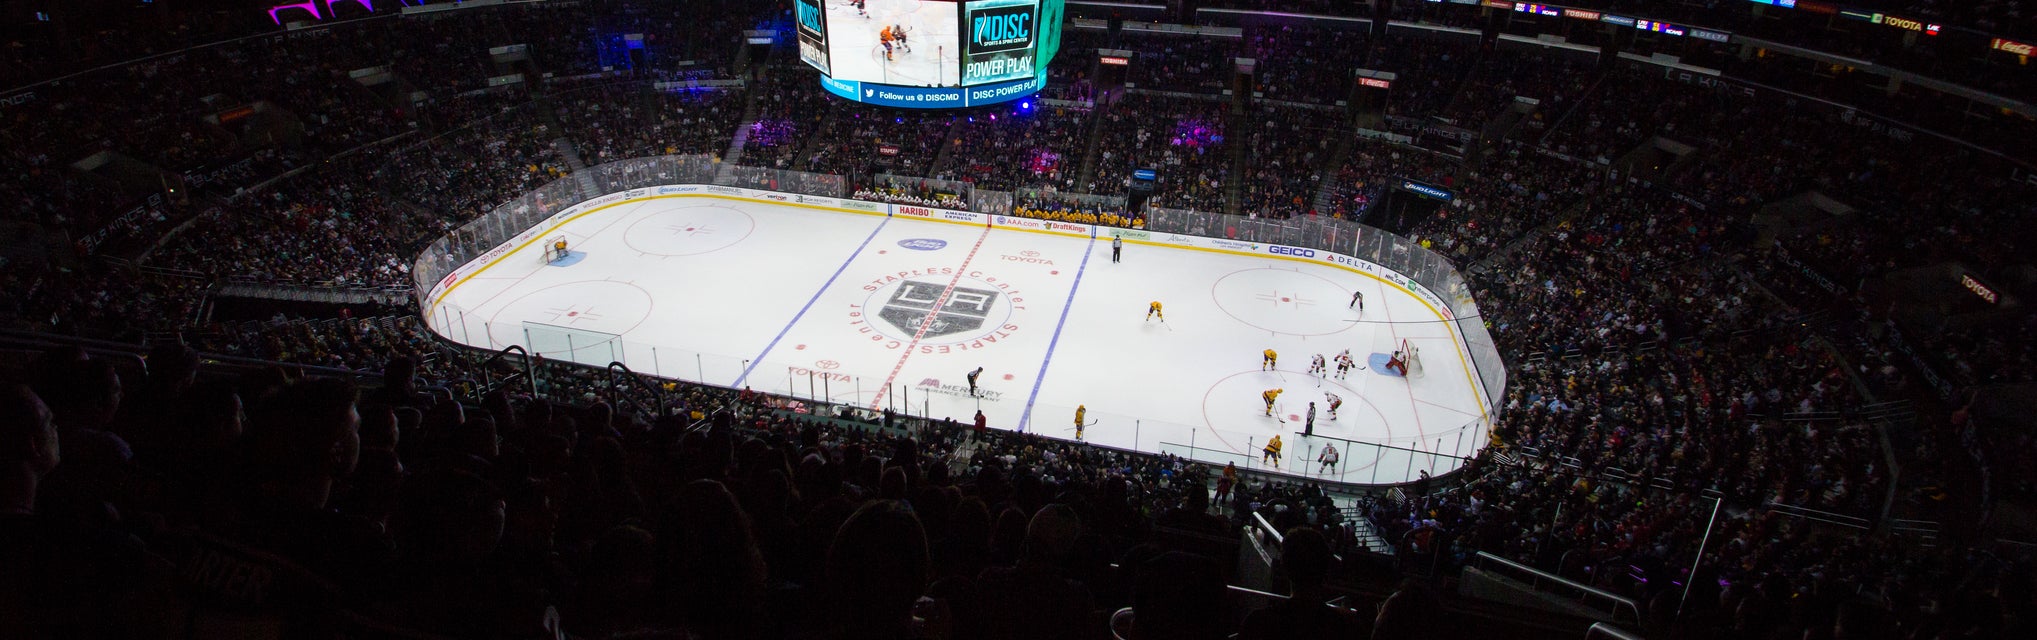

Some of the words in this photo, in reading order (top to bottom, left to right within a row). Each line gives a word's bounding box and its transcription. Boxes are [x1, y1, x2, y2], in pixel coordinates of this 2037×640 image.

[1564, 9, 1599, 20] TOSHIBA
[1885, 16, 1922, 31] TOYOTA
[1701, 31, 1728, 41] DELTA
[967, 60, 1004, 79] POWER
[1007, 56, 1032, 74] PLAY
[1101, 57, 1128, 65] TOSHIBA
[973, 90, 995, 99] DISC
[996, 84, 1022, 96] POWER
[1024, 79, 1037, 91] PLAY
[880, 91, 903, 100] Follow
[926, 93, 959, 101] DISCMD
[1424, 188, 1447, 197] LIGHT
[900, 206, 929, 217] HARIBO
[108, 205, 147, 233] KINGS
[1007, 219, 1039, 228] AAA.com
[1053, 222, 1086, 233] DraftKings
[489, 242, 513, 259] TOYOTA
[1269, 246, 1315, 258] GEICO
[1001, 254, 1054, 265] TOYOTA
[1338, 256, 1373, 271] DELTA
[863, 267, 952, 292] STAPLES
[970, 271, 1026, 310] Center
[1962, 274, 1996, 303] TOYOTA
[920, 323, 1019, 354] STAPLES
[789, 366, 851, 383] TOYOTA
